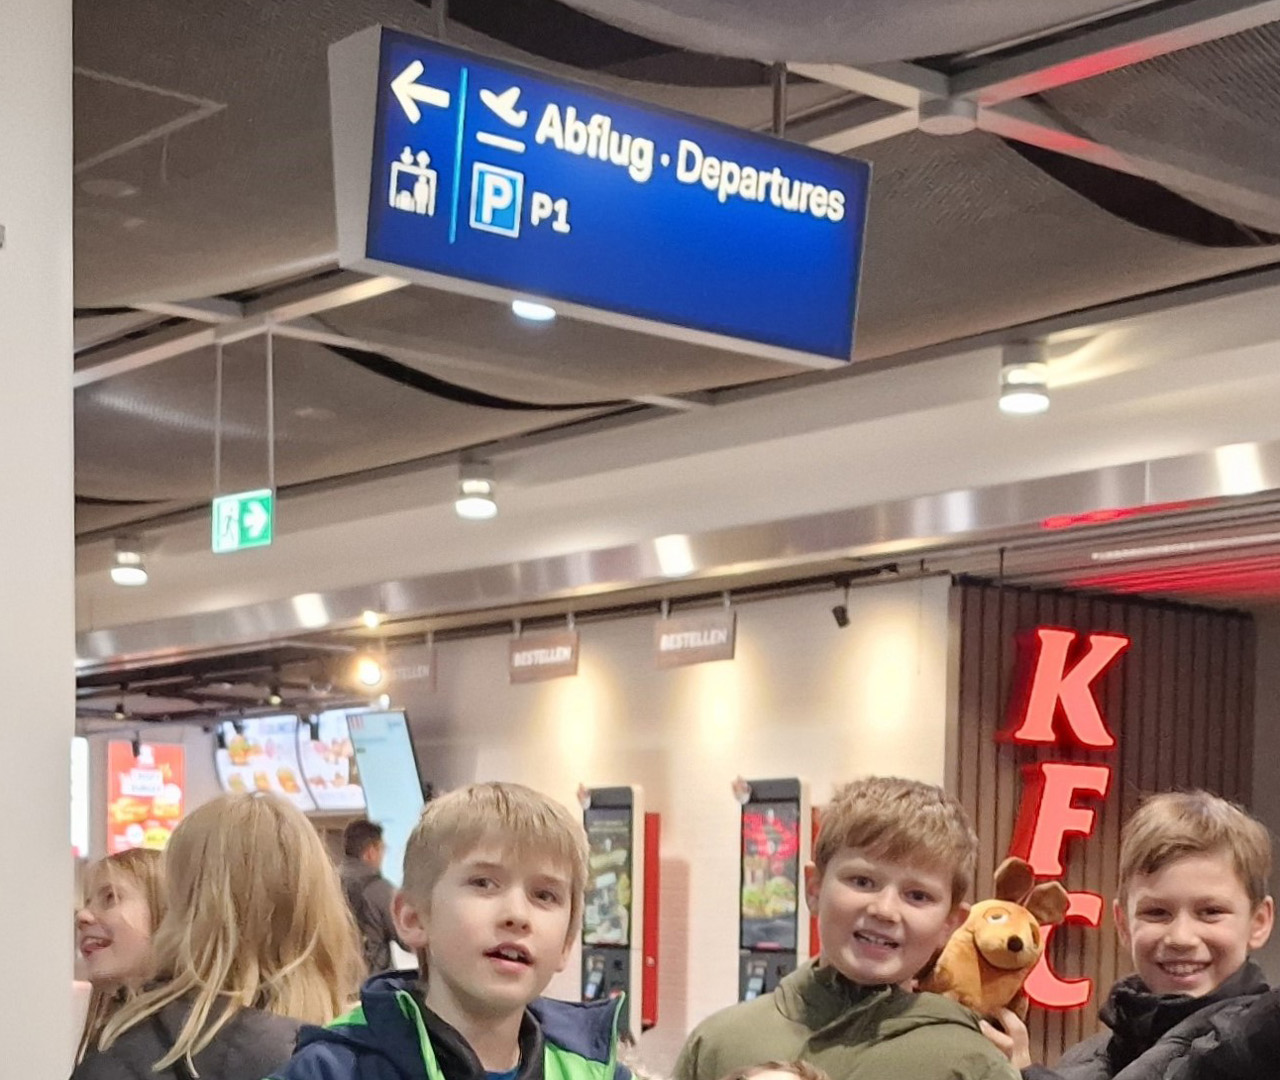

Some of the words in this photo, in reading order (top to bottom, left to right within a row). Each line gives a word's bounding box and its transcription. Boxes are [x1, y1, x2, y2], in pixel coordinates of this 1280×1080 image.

[534, 102, 655, 184] Abflug
[675, 138, 846, 223] Departures
[481, 172, 514, 225] P
[530, 190, 571, 234] P1
[513, 646, 573, 668] BESTELLEN
[659, 628, 728, 652] BESTELLEN
[1013, 627, 1131, 1010] KFC
